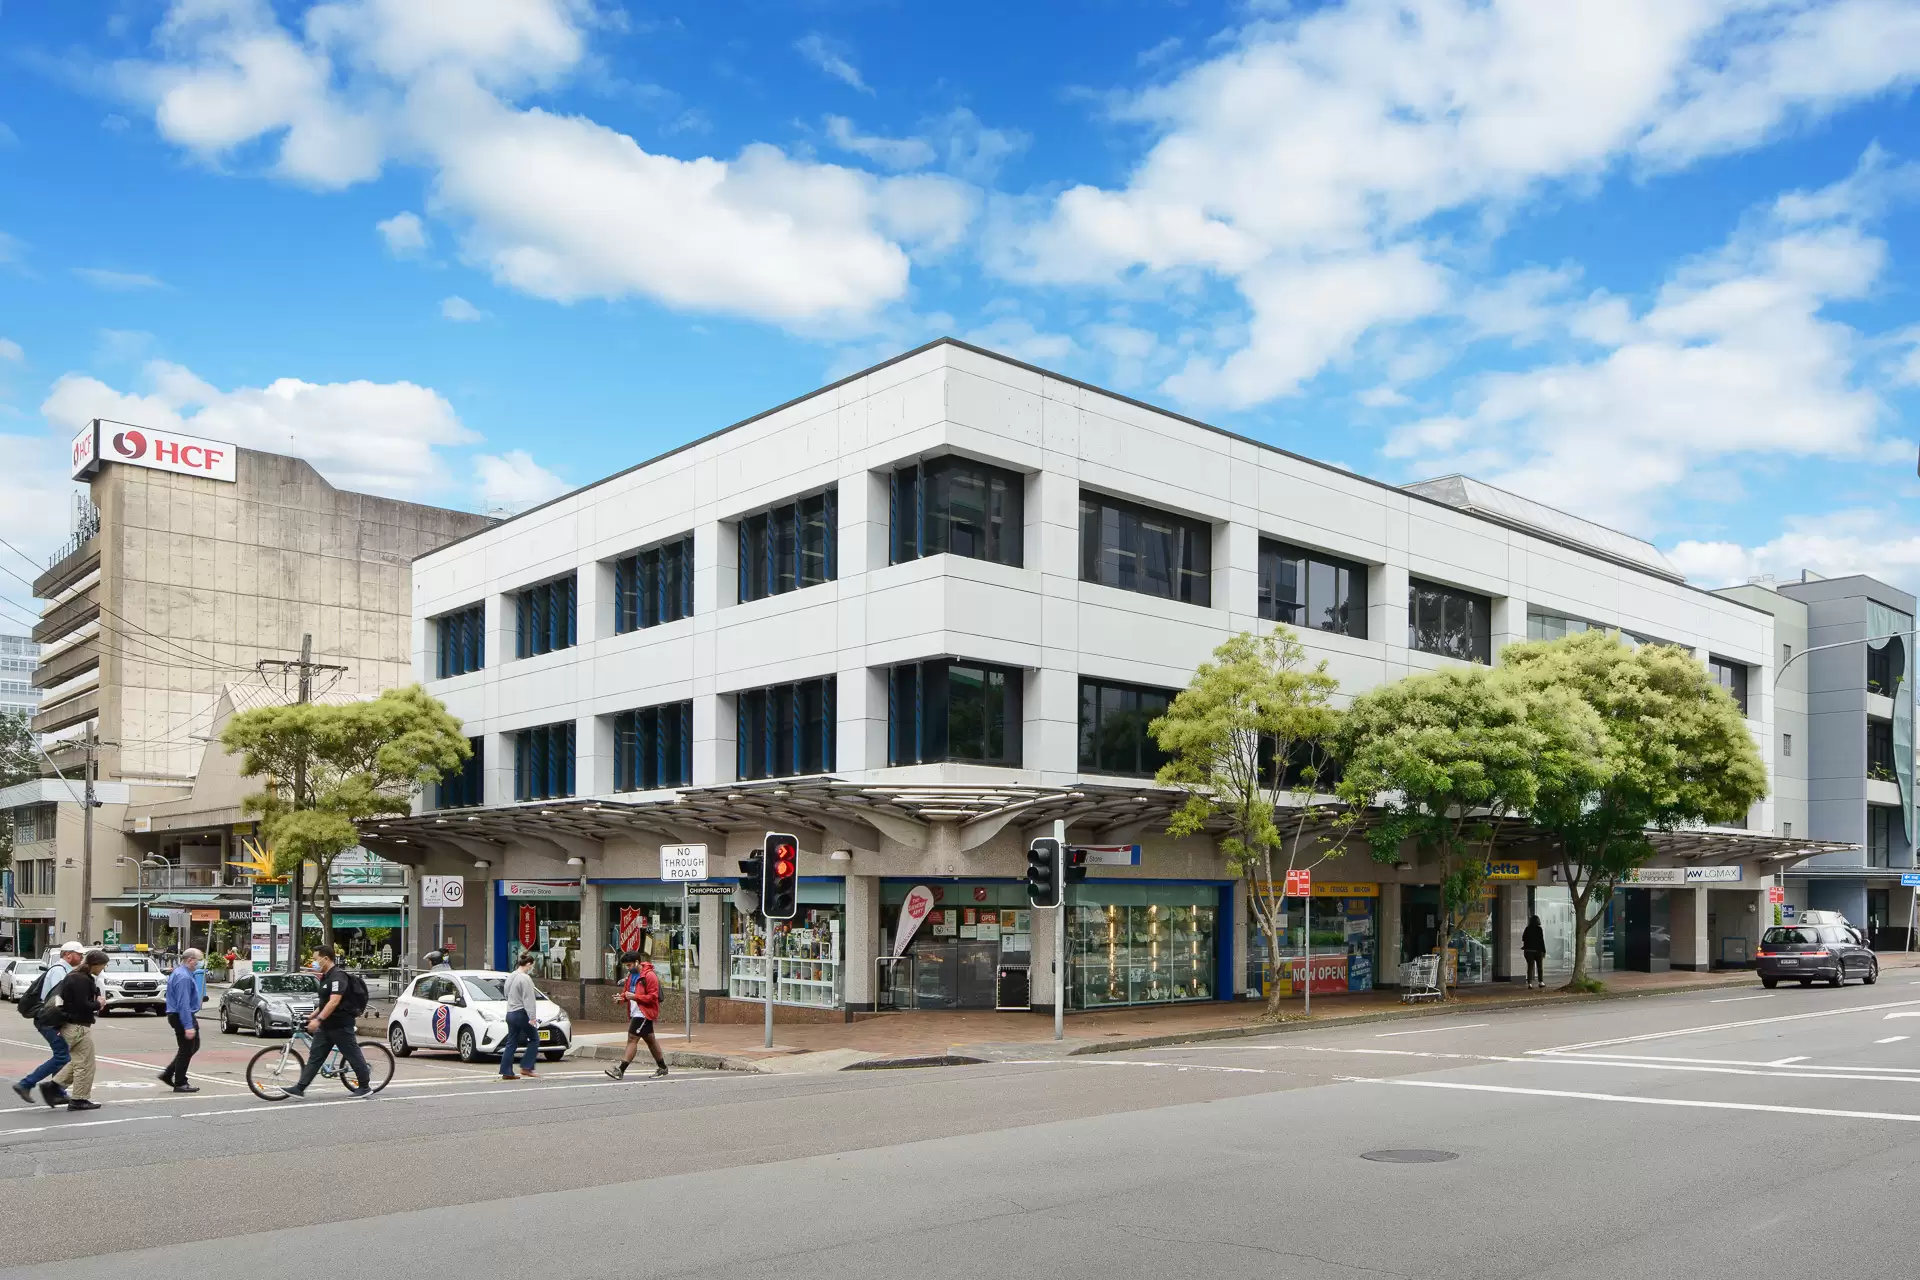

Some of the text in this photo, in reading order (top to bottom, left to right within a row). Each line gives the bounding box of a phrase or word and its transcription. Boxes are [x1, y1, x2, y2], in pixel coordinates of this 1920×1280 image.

[79, 434, 92, 461] HCF
[155, 440, 224, 470] HCF
[677, 848, 691, 856] NO
[664, 858, 705, 867] THROUGH
[671, 869, 698, 878] ROAD
[1704, 869, 1737, 878] LOMAX
[446, 886, 461, 896] 40
[254, 896, 275, 905] Amway
[1318, 965, 1346, 980] OPEN!
